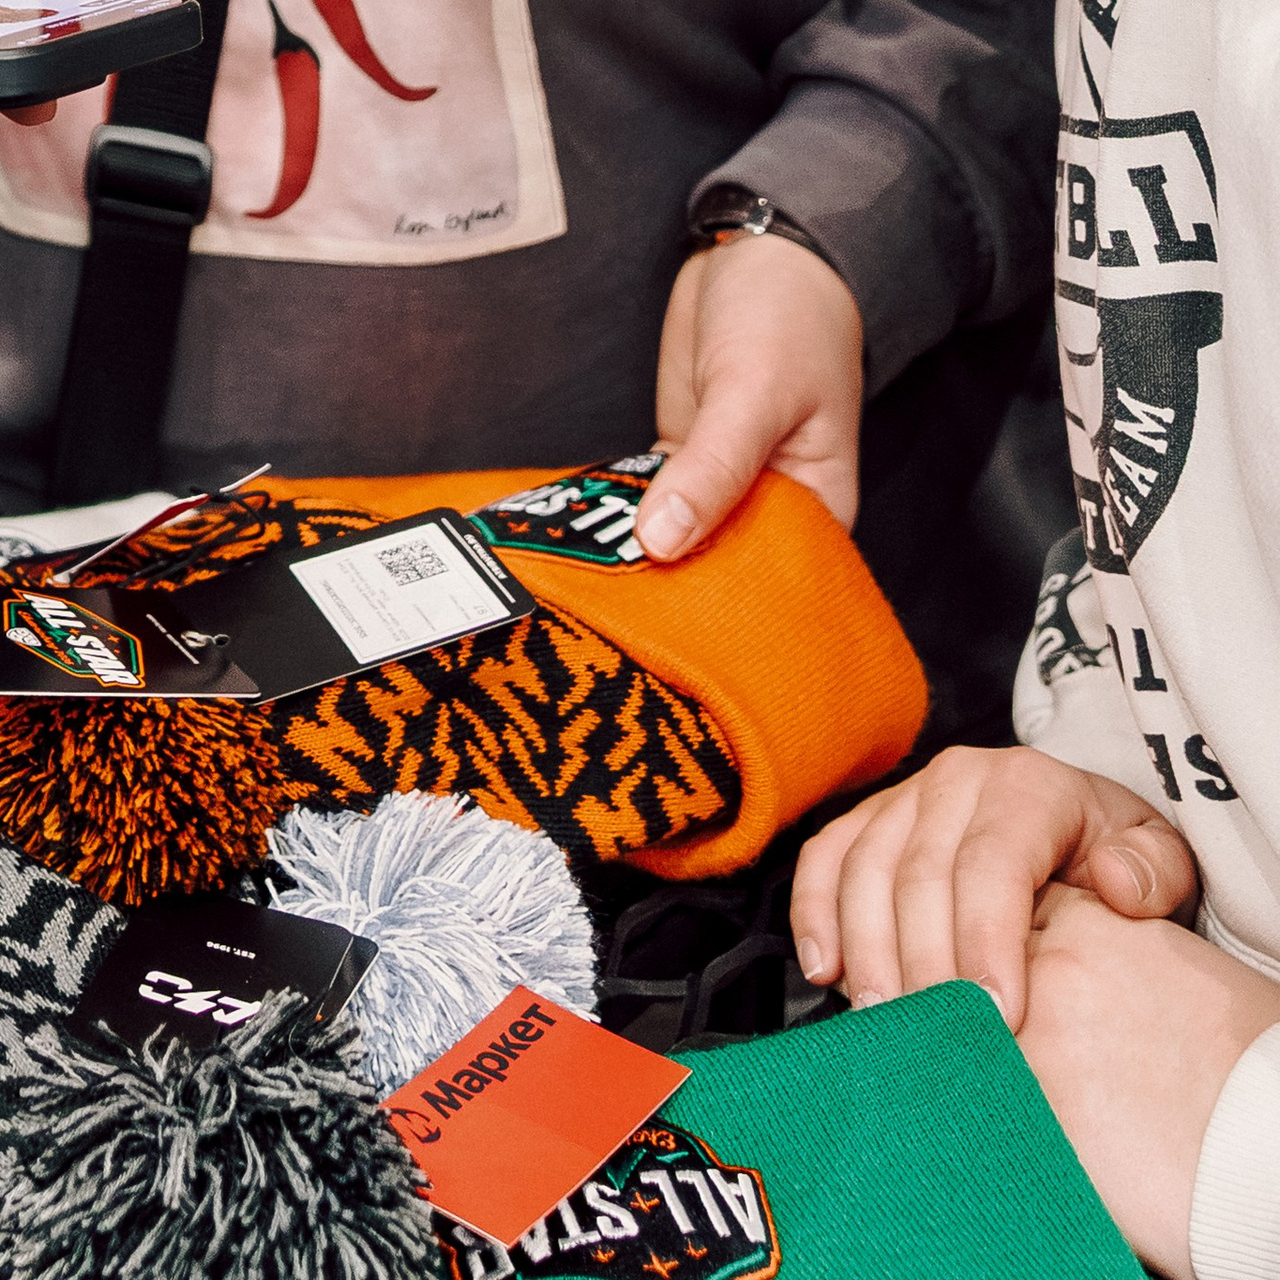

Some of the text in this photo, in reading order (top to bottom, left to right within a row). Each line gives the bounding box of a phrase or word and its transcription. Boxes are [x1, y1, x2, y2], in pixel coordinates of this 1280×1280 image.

[22, 593, 140, 685] ALL STAR
[420, 1002, 558, 1119] Маркет
[639, 1168, 767, 1243] ALL
